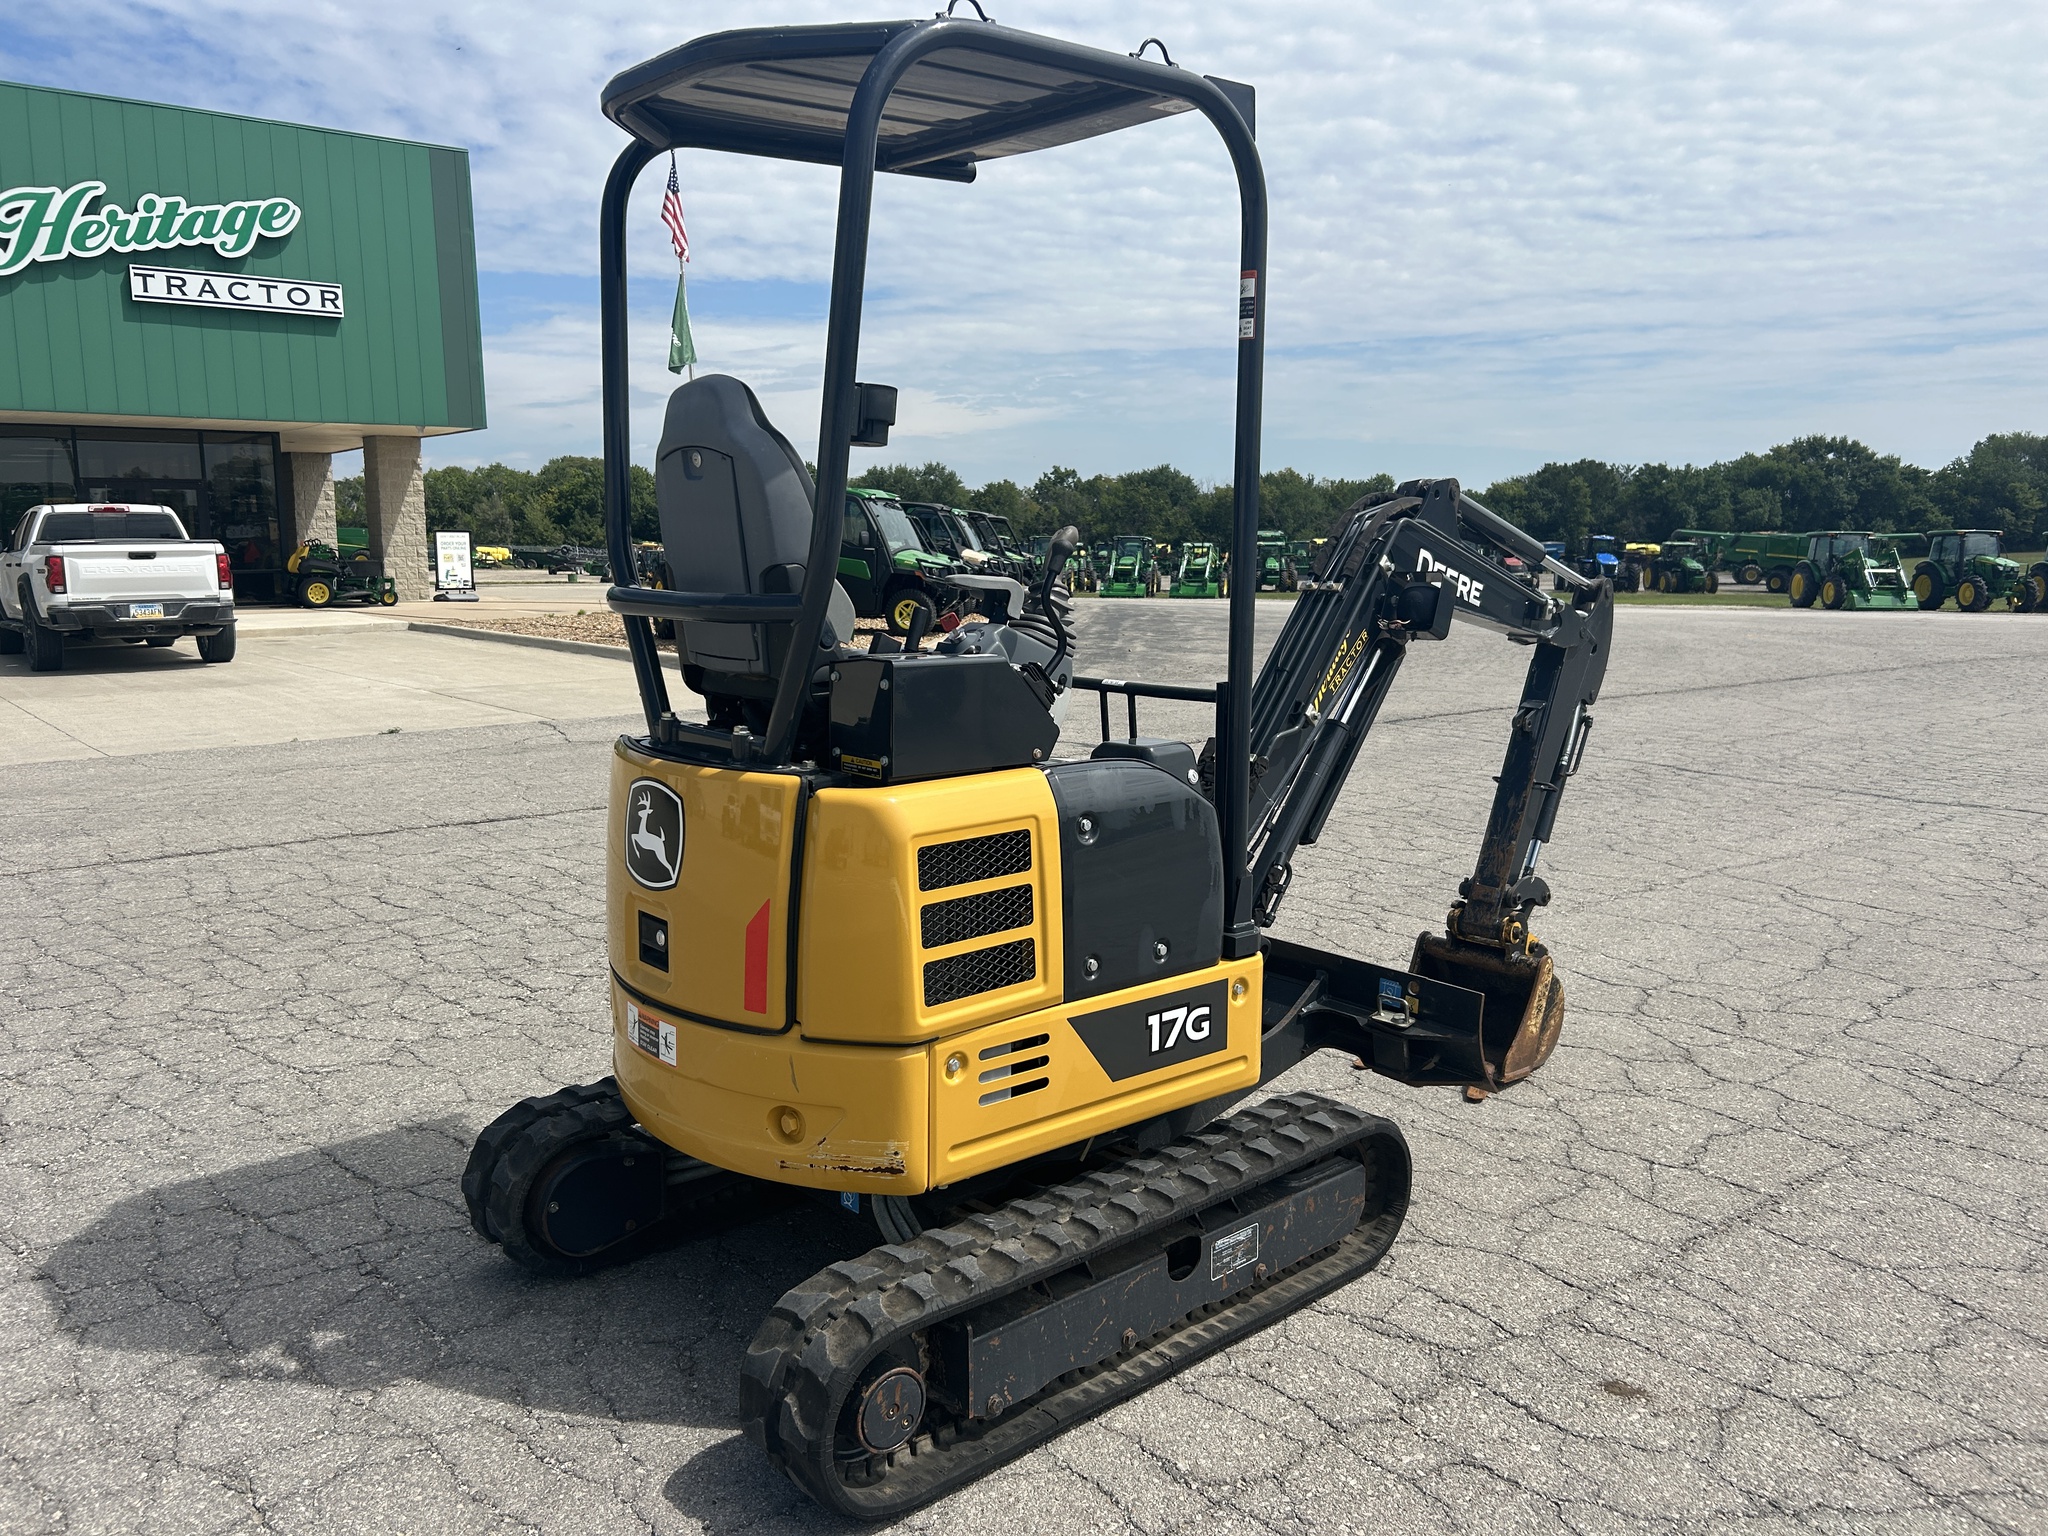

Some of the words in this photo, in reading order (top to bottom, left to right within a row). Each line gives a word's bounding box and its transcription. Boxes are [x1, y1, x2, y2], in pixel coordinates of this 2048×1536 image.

[0, 181, 301, 274] Heritage
[133, 271, 341, 309] TRACTOR
[82, 564, 203, 576] CHEVROLET
[1329, 630, 1368, 692] TRACTOR
[855, 758, 873, 766] CAUTION
[1147, 1006, 1210, 1052] 17G
